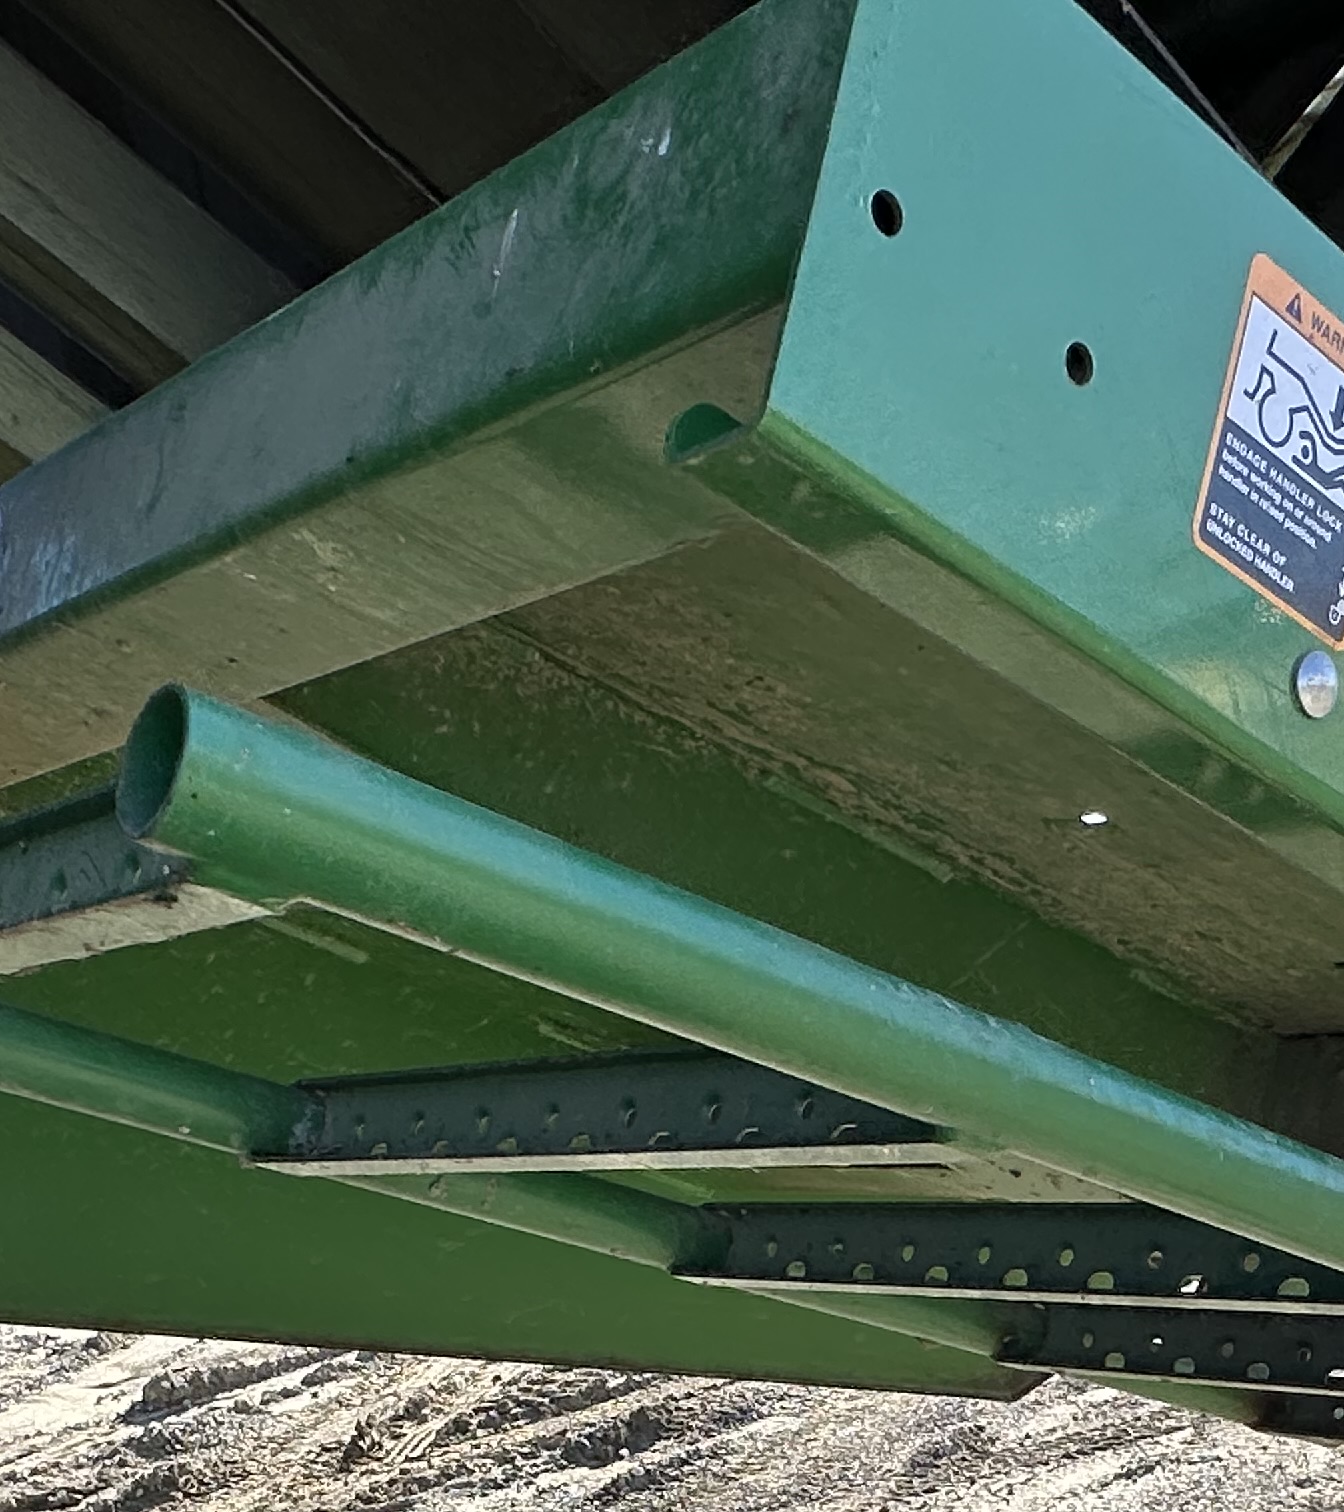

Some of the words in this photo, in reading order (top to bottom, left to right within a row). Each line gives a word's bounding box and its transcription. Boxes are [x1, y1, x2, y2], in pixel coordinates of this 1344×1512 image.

[1217, 462, 1250, 497] handler
[1220, 446, 1250, 479] before
[1249, 469, 1282, 506] working
[1302, 512, 1333, 544] around
[1224, 429, 1268, 475] ENGAGE
[1268, 464, 1315, 512] HANDLER
[1315, 503, 1343, 534] LOCK
[1204, 516, 1255, 564] UNLOCKED
[1208, 500, 1236, 531] STAY
[1235, 520, 1272, 558] CLEAR
[1270, 547, 1287, 570] OF
